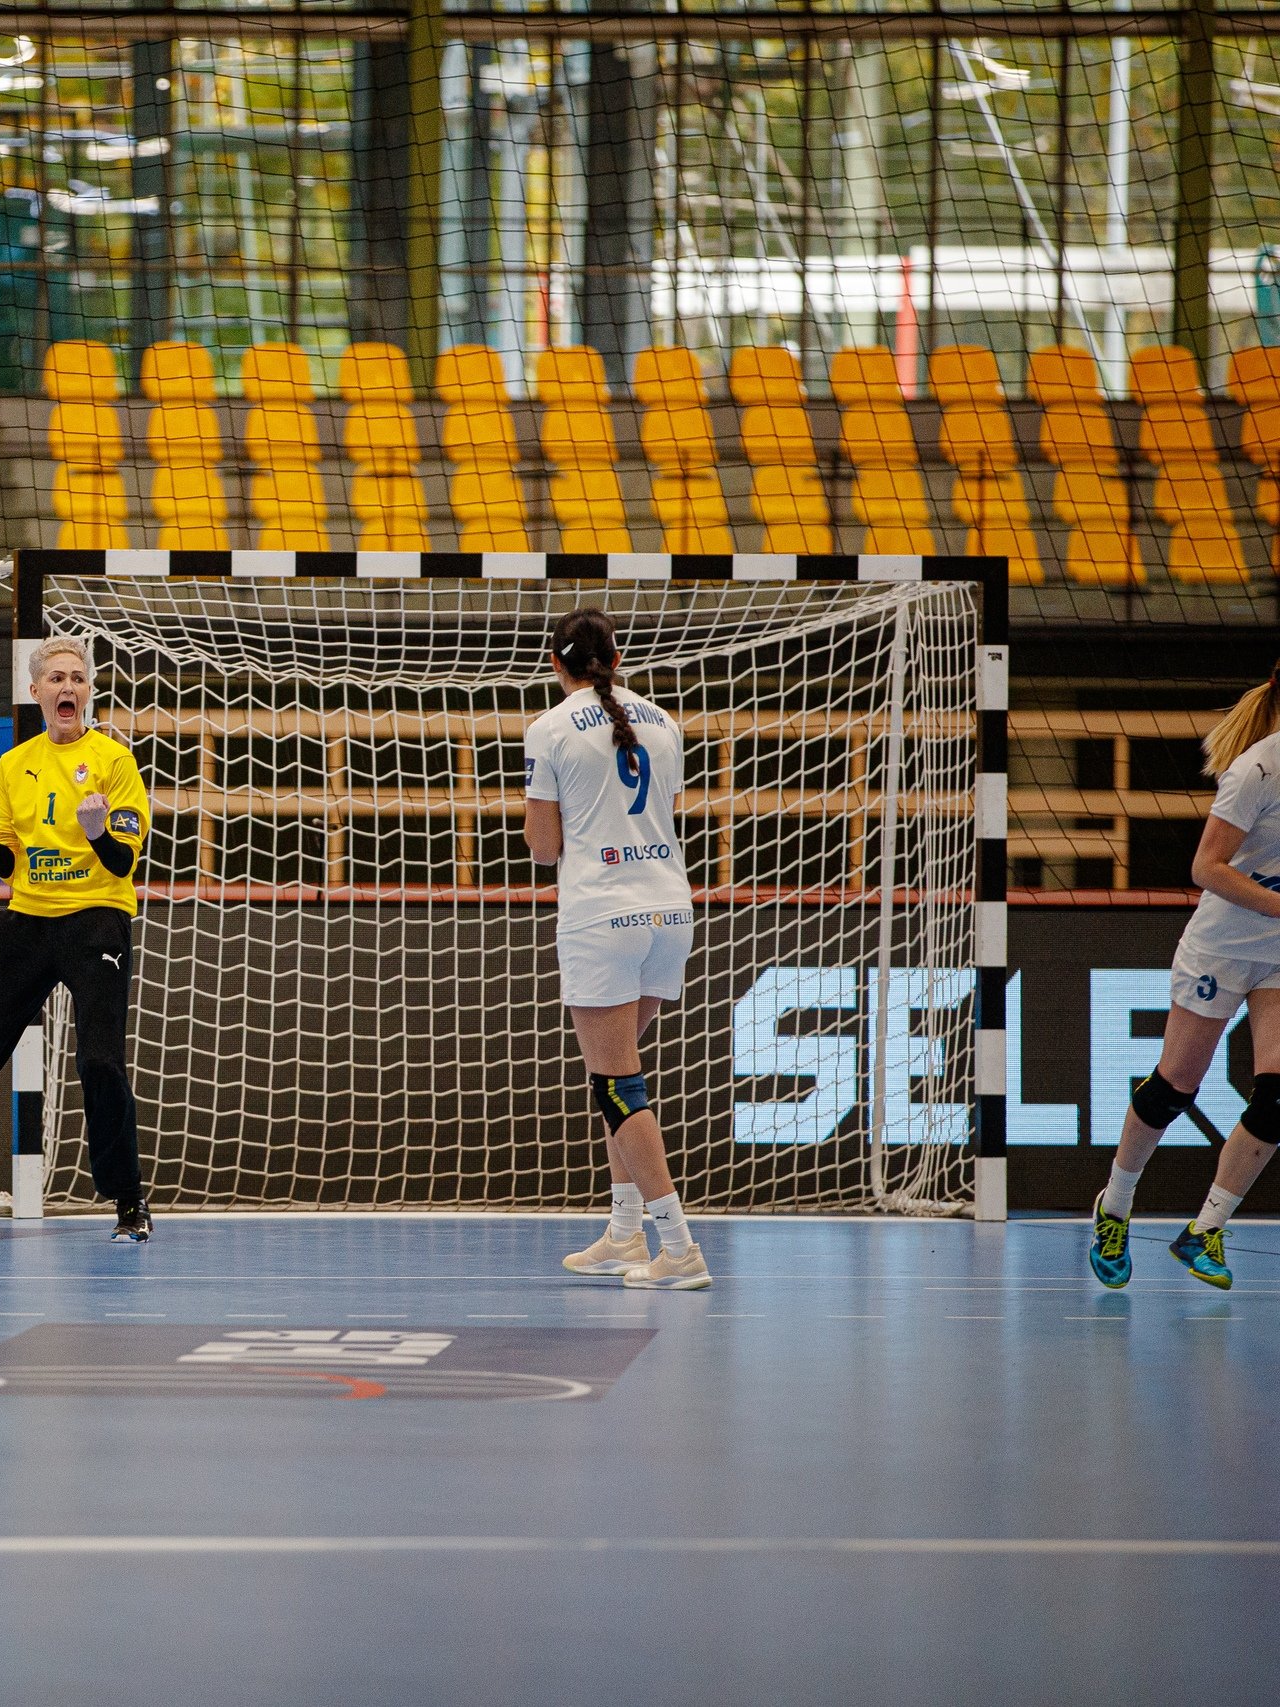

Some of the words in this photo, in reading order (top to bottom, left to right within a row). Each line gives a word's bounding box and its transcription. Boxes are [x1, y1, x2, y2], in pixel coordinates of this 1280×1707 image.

[570, 703, 667, 732] GORENINA
[616, 744, 651, 816] 9
[42, 792, 56, 826] 1
[26, 846, 73, 870] Trans
[623, 843, 674, 862] RUSCO
[611, 911, 692, 930] RUSSEQUELLE
[1196, 974, 1218, 1001] 3
